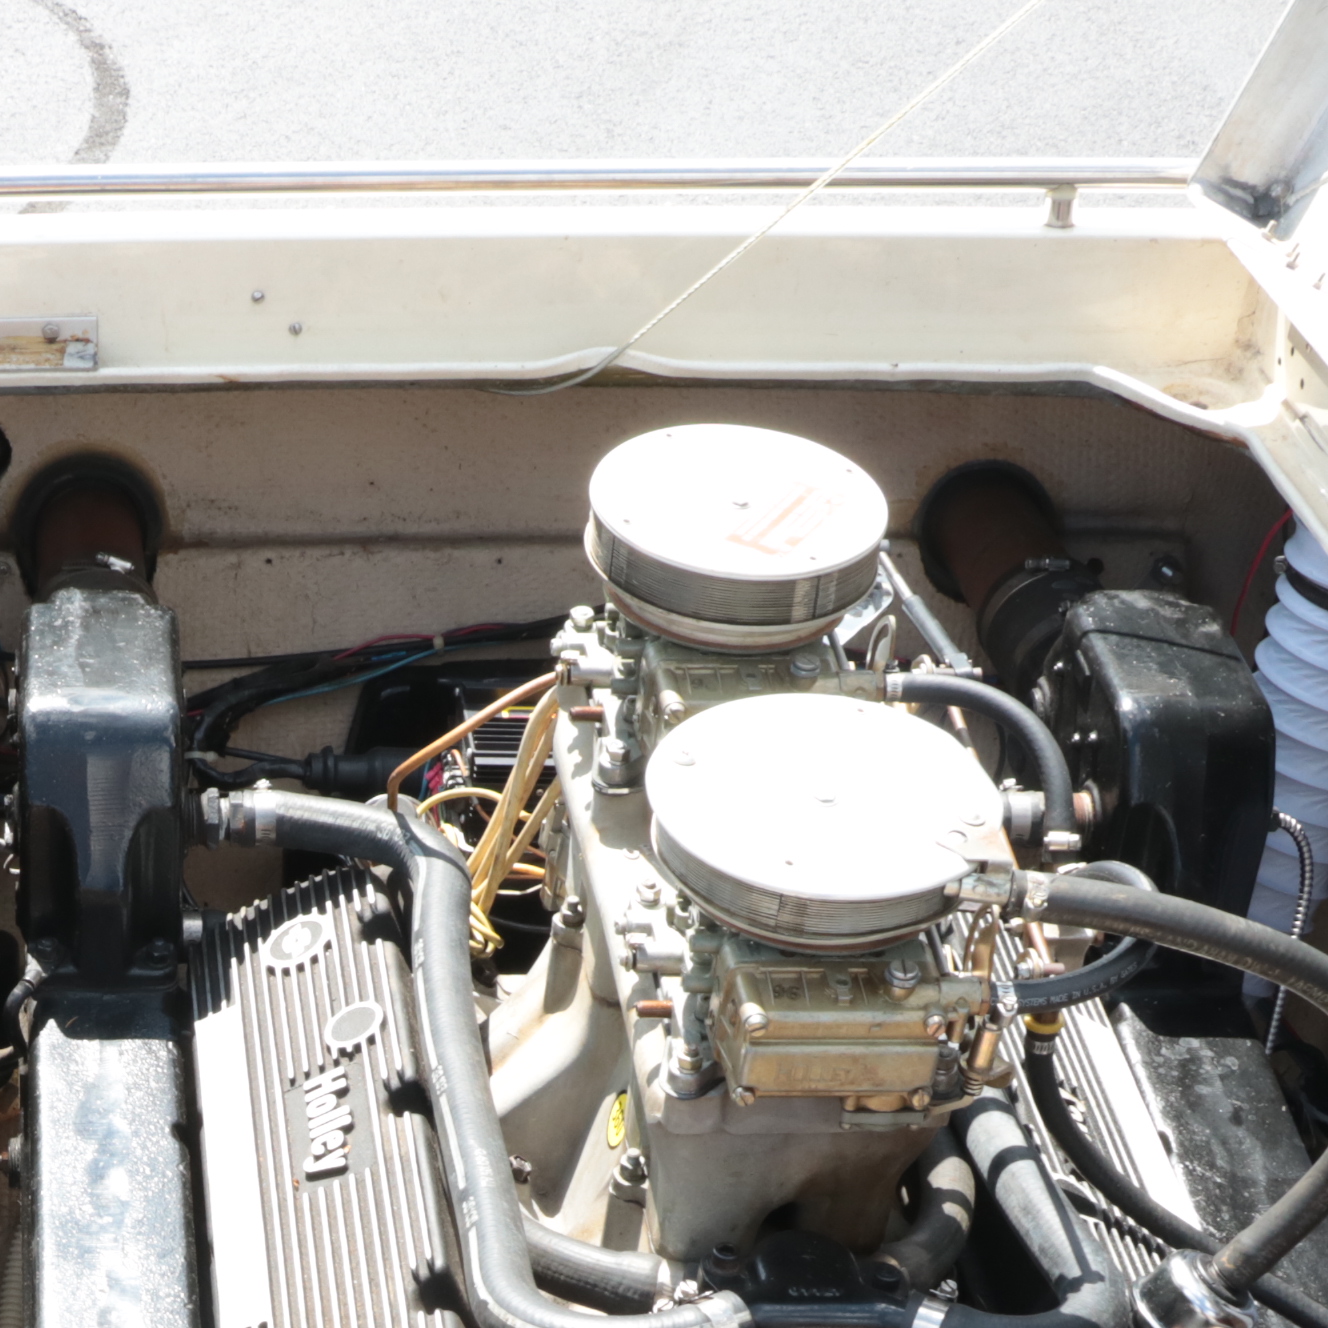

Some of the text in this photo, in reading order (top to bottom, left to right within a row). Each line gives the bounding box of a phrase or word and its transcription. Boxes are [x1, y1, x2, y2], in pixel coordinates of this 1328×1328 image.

[1050, 993, 1068, 1004] MADE
[1072, 989, 1082, 1000] IN
[303, 1066, 353, 1173] Holley
